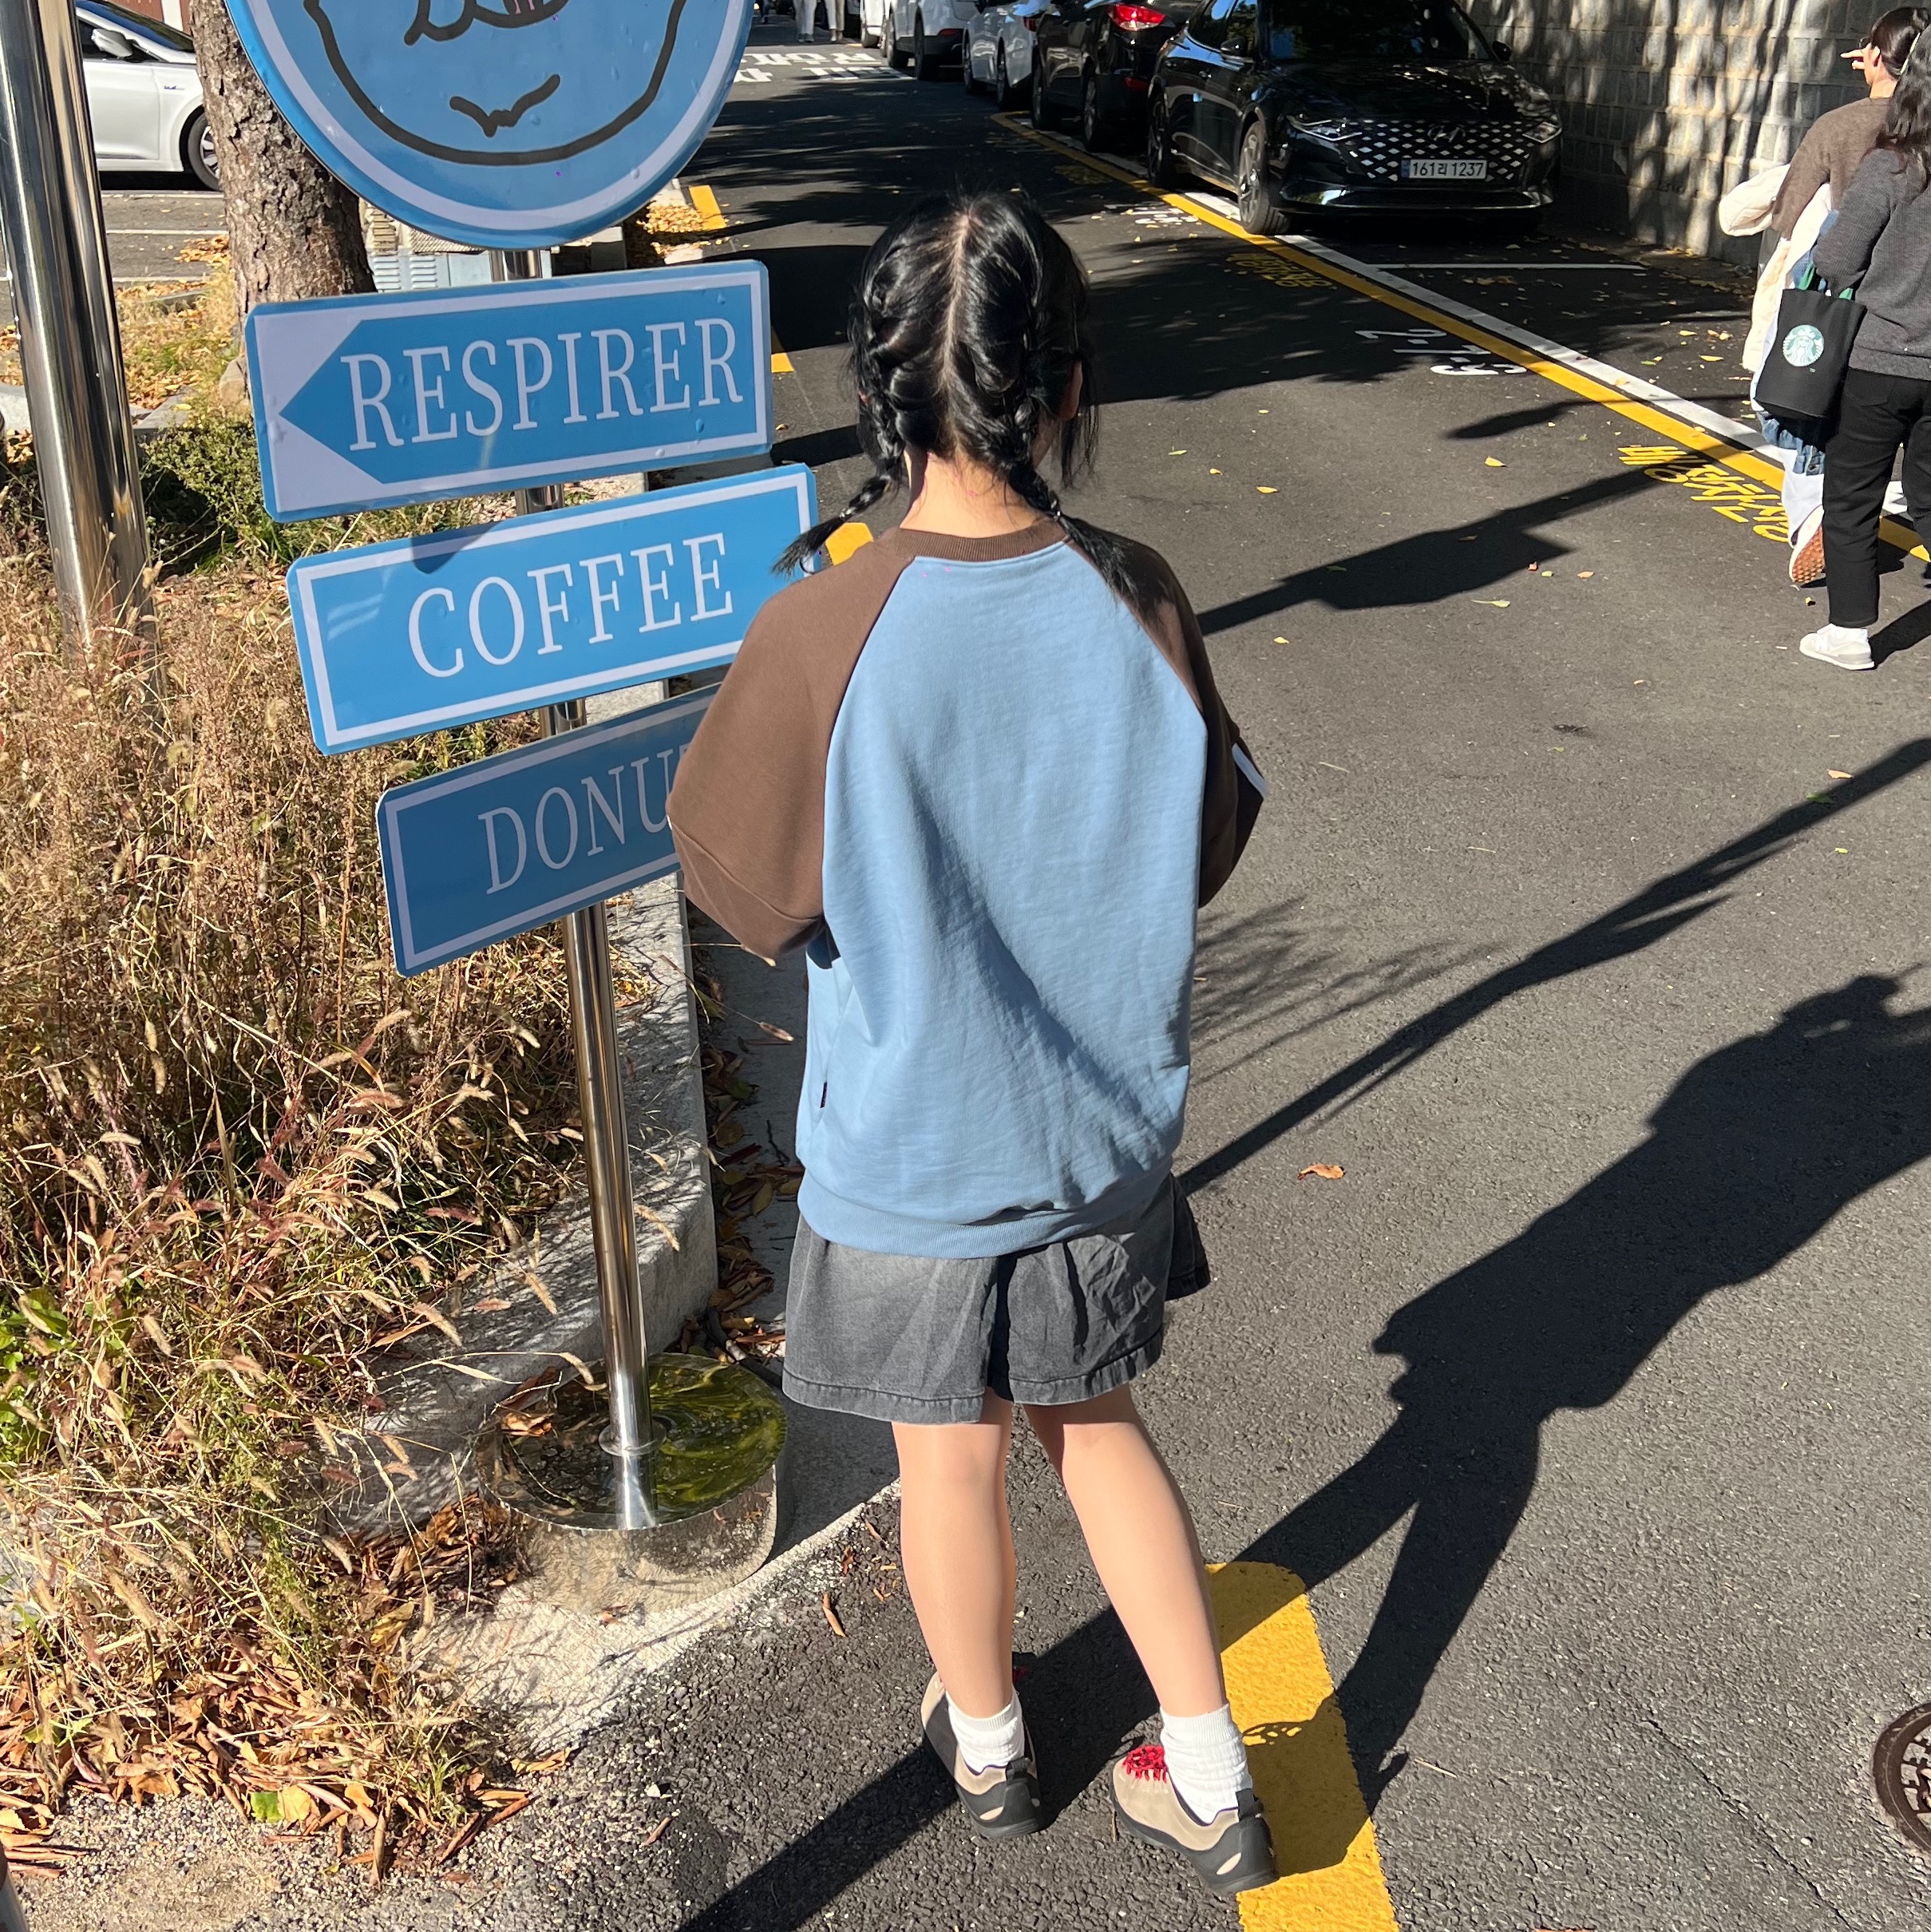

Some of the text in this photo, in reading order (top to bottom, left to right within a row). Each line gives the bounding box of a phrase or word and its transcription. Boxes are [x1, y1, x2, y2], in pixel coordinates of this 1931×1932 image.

[1451, 162, 1484, 176] 1237
[340, 317, 744, 452] RESPIRER
[408, 532, 734, 679] COFFEE
[477, 744, 687, 895] DONU
